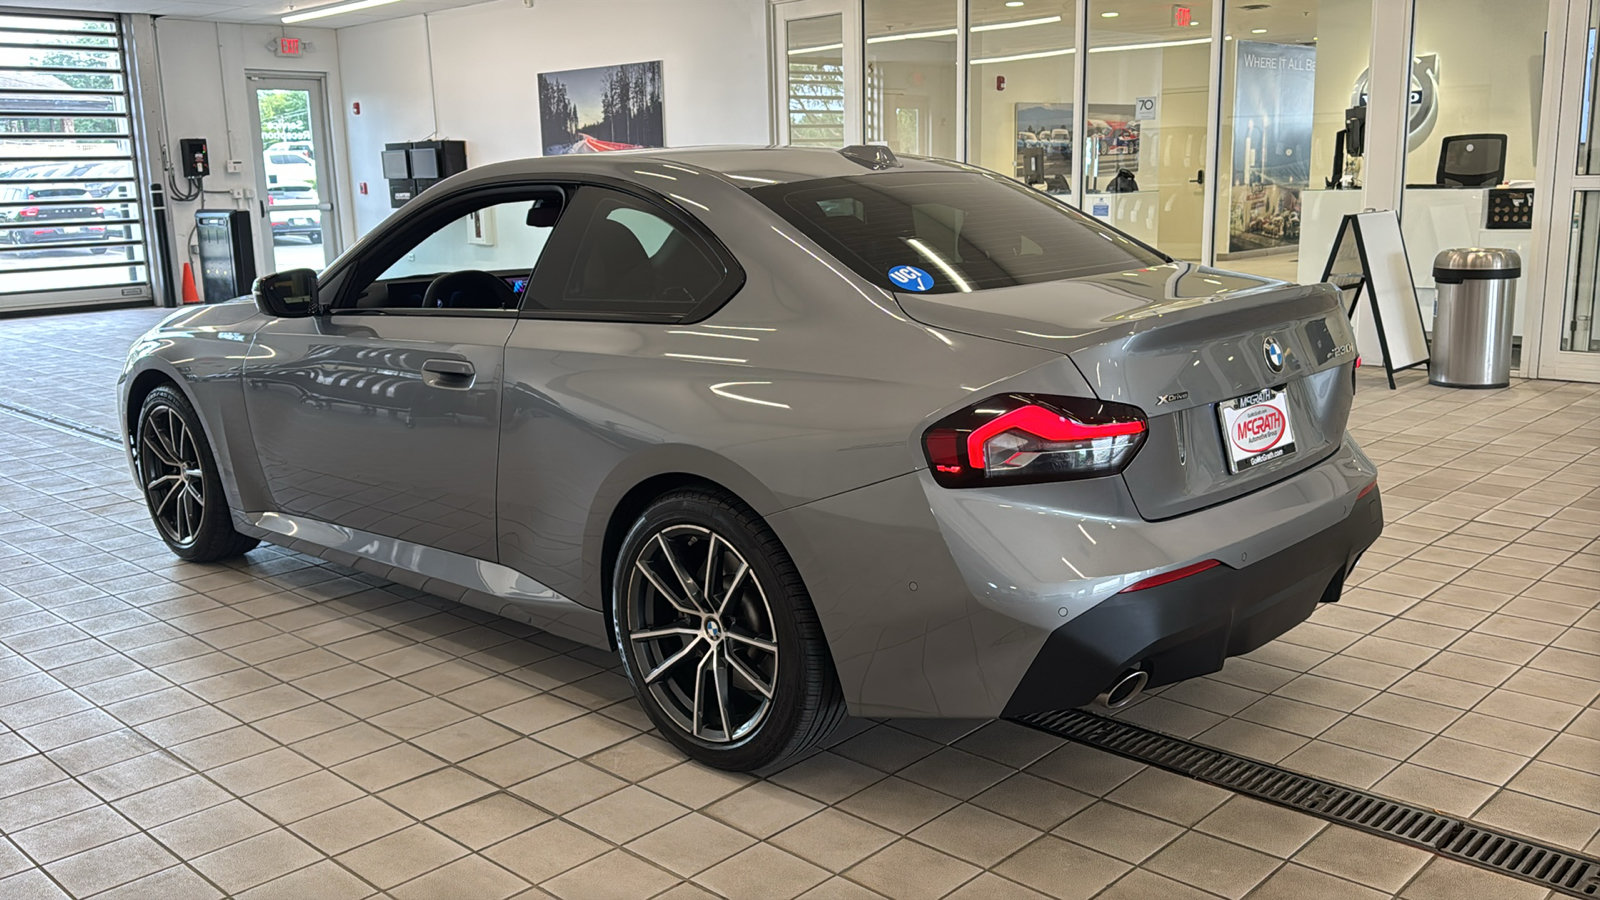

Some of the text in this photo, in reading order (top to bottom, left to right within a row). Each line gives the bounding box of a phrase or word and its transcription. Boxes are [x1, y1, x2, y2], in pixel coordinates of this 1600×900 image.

[281, 38, 299, 54] EXIT
[1244, 53, 1277, 69] WHERE
[1279, 56, 1287, 69] IT
[1288, 57, 1304, 71] ALL
[1138, 99, 1154, 111] 70
